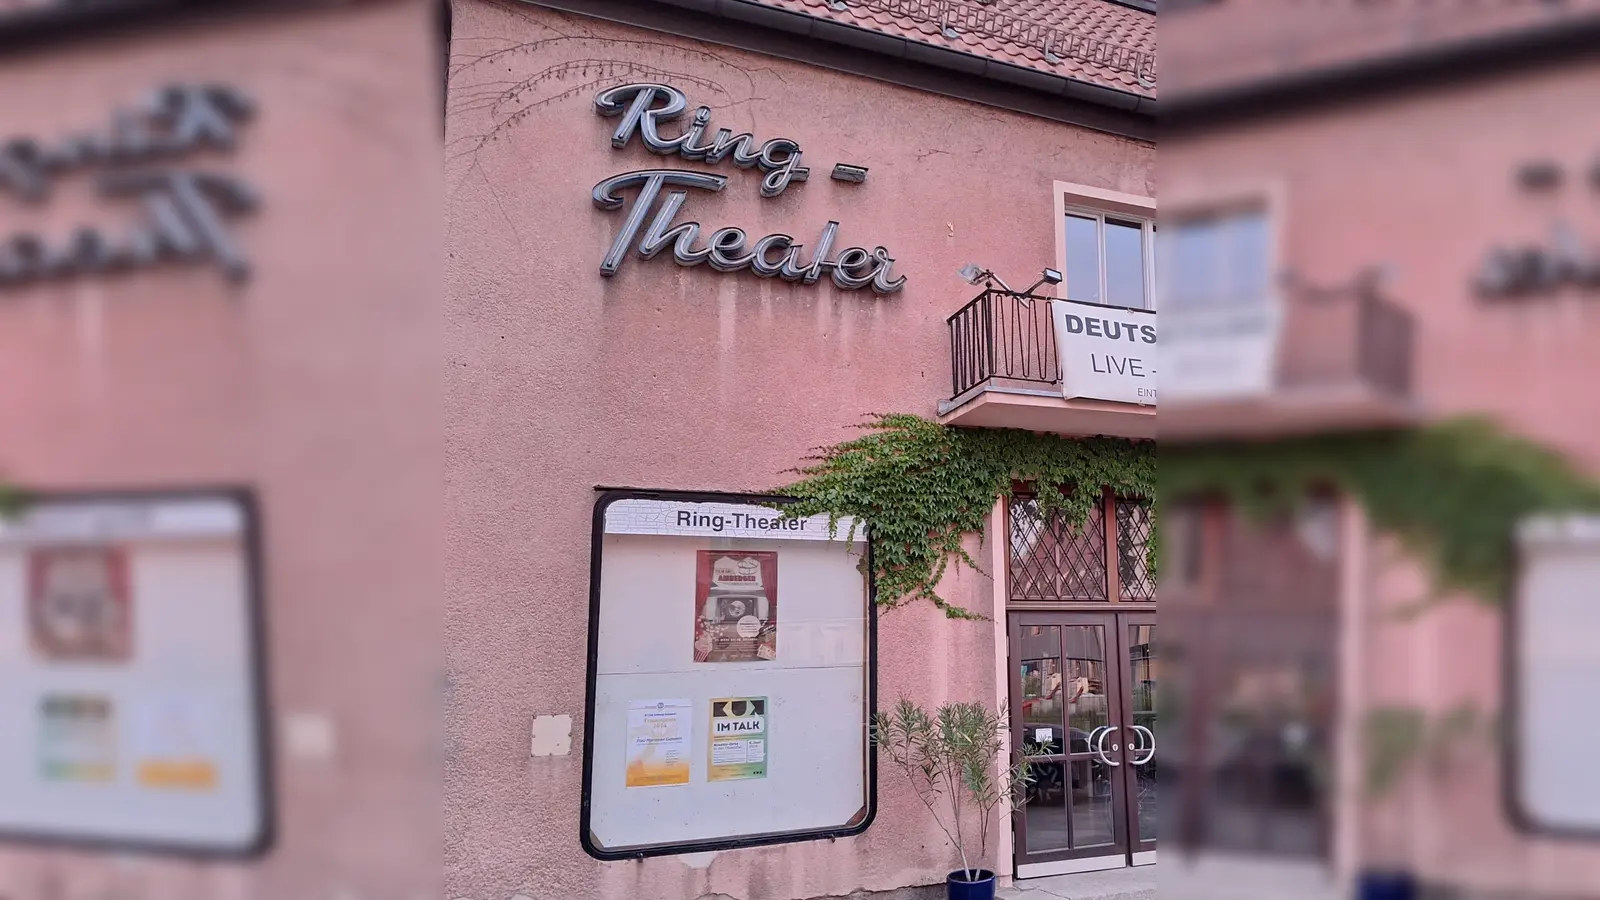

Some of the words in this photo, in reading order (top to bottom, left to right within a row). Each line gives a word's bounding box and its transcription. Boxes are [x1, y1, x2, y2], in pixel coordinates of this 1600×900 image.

[596, 82, 811, 198] Ring
[591, 168, 908, 294] Theater
[1065, 314, 1157, 344] DEUTS
[1091, 353, 1146, 377] LIVE
[677, 510, 807, 532] Ring-Theater
[717, 723, 730, 731] IM
[733, 721, 760, 731] TALK
